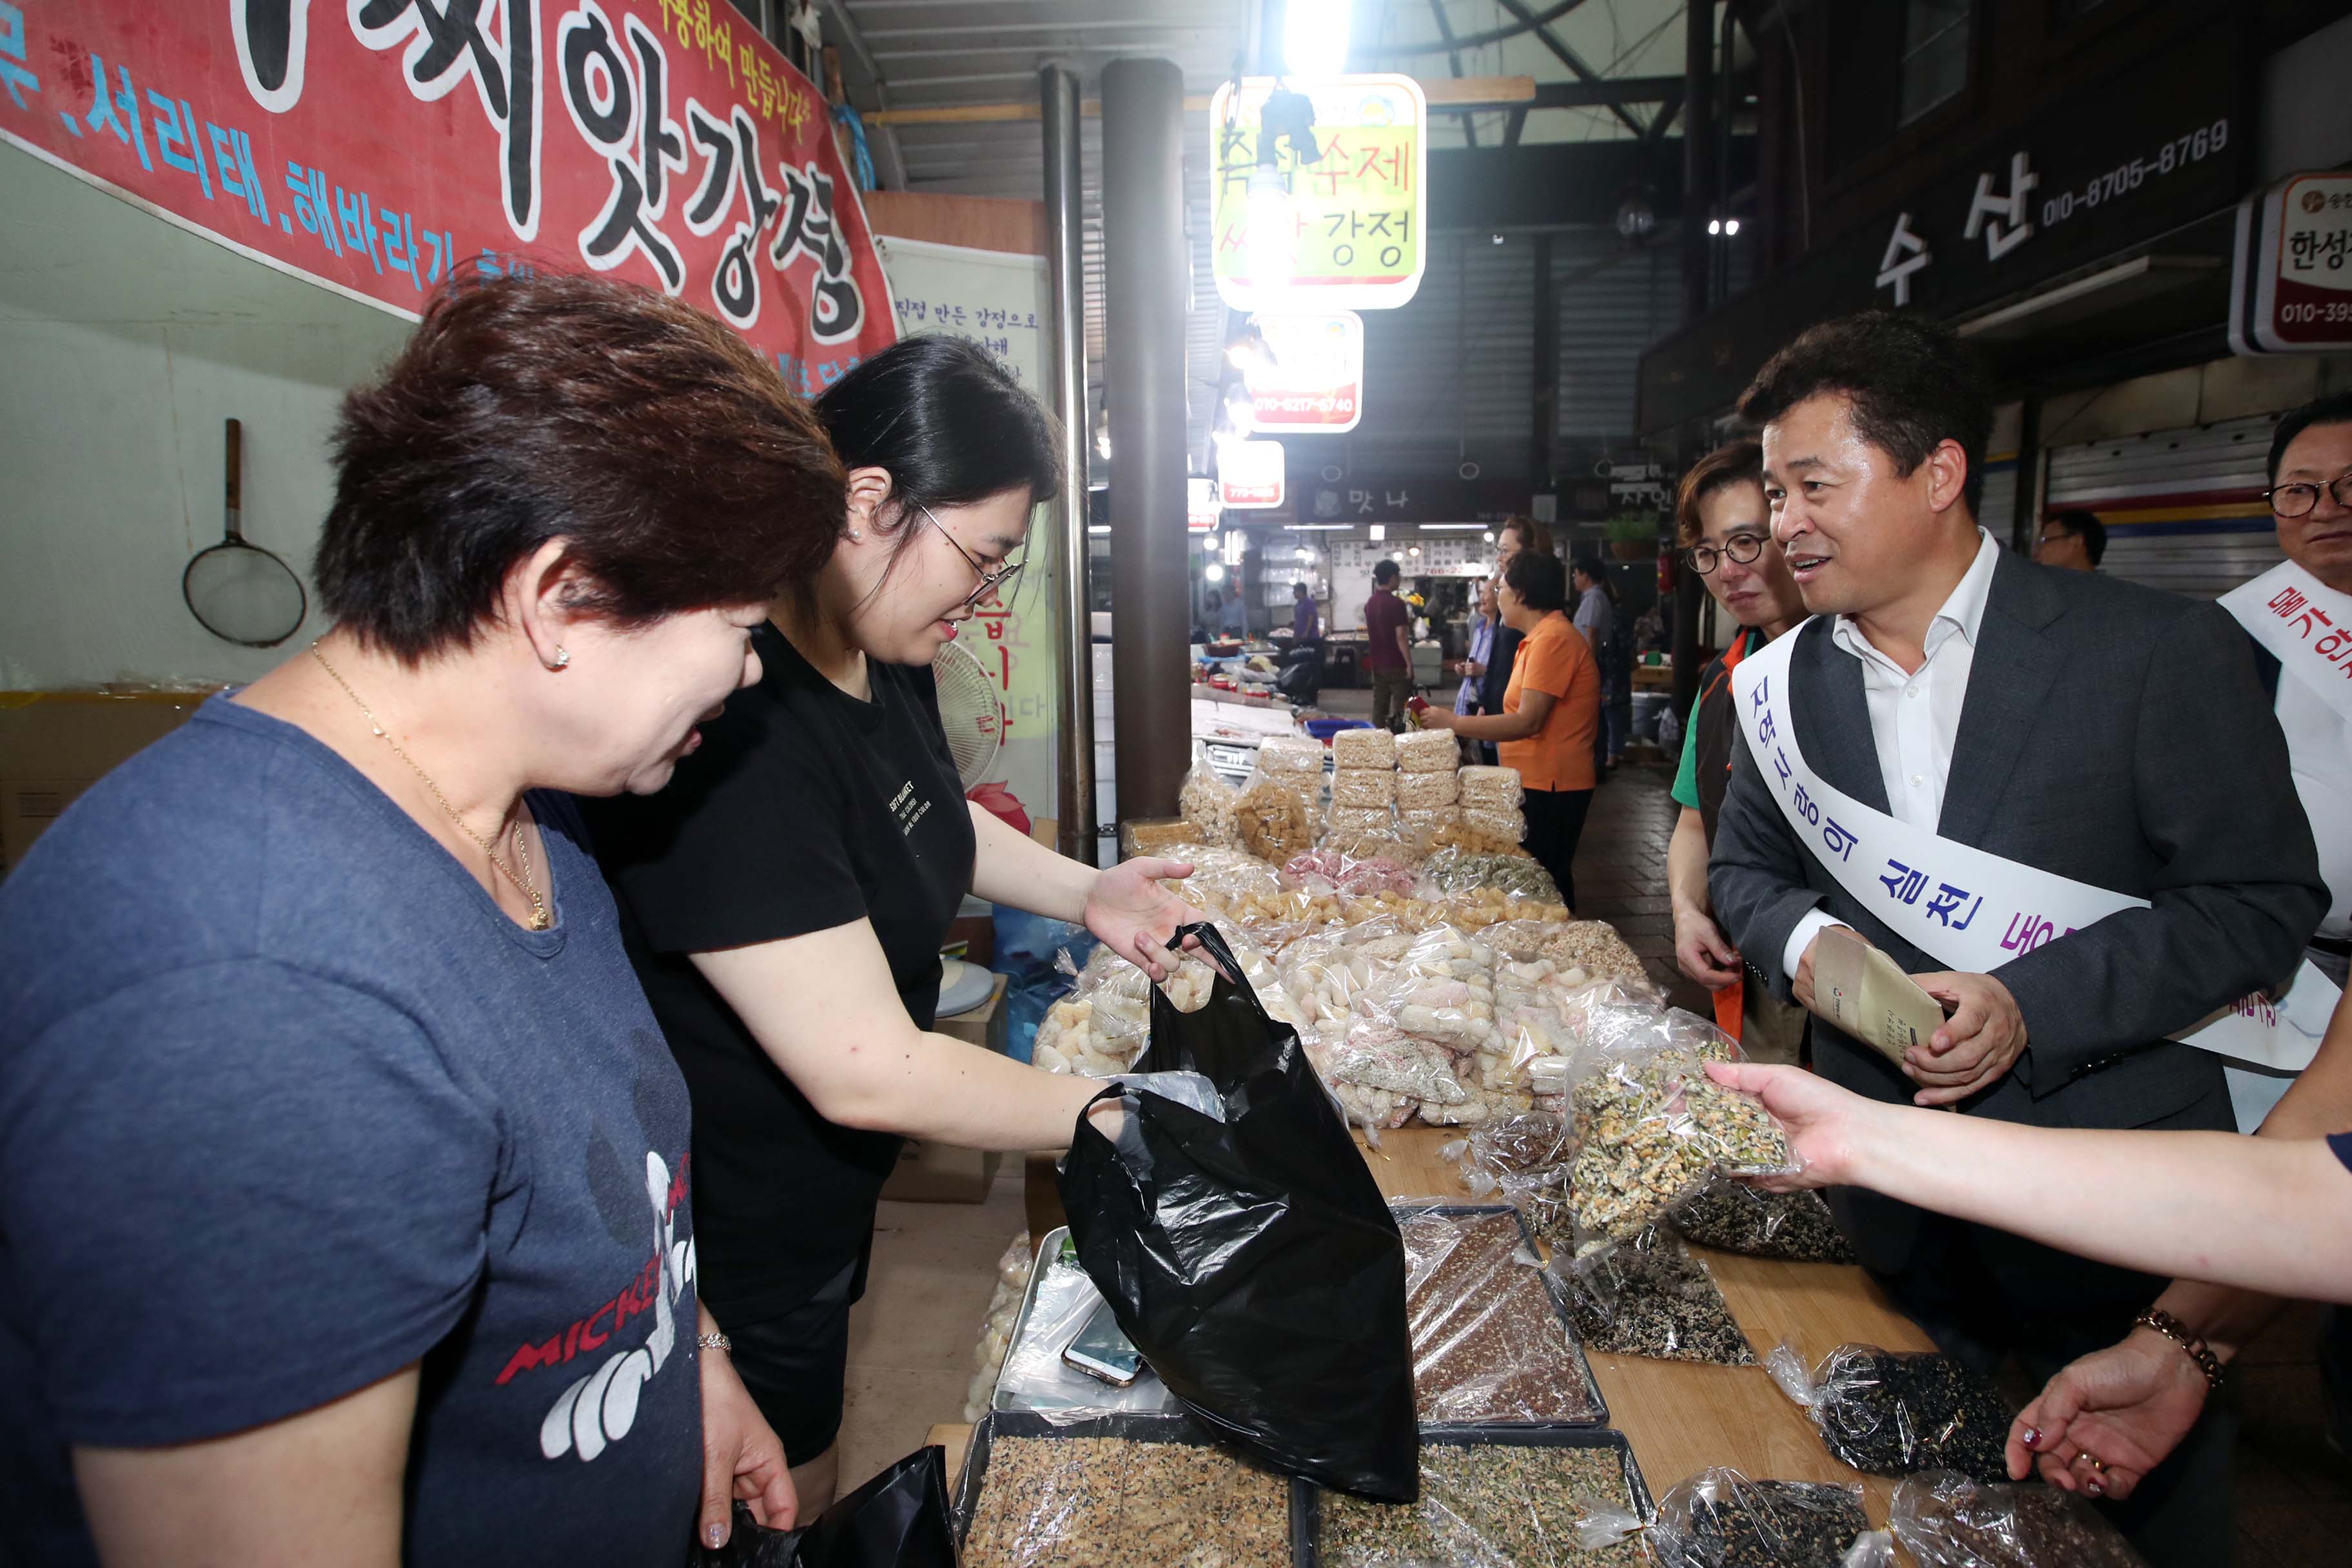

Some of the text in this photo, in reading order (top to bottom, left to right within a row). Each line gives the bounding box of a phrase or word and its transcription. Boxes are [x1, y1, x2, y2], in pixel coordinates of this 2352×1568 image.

[658, 0, 734, 89] 용하여
[1315, 133, 1409, 196] 수제
[2043, 119, 2228, 227] 010-8705-8769
[1324, 210, 1409, 268] 강정
[2289, 230, 2352, 270] 한성
[935, 304, 966, 326] 만든
[975, 308, 1039, 329] 강정으로
[1879, 859, 1984, 930] 실천
[2000, 912, 2077, 957] 동
[495, 1251, 661, 1385] MICKE
